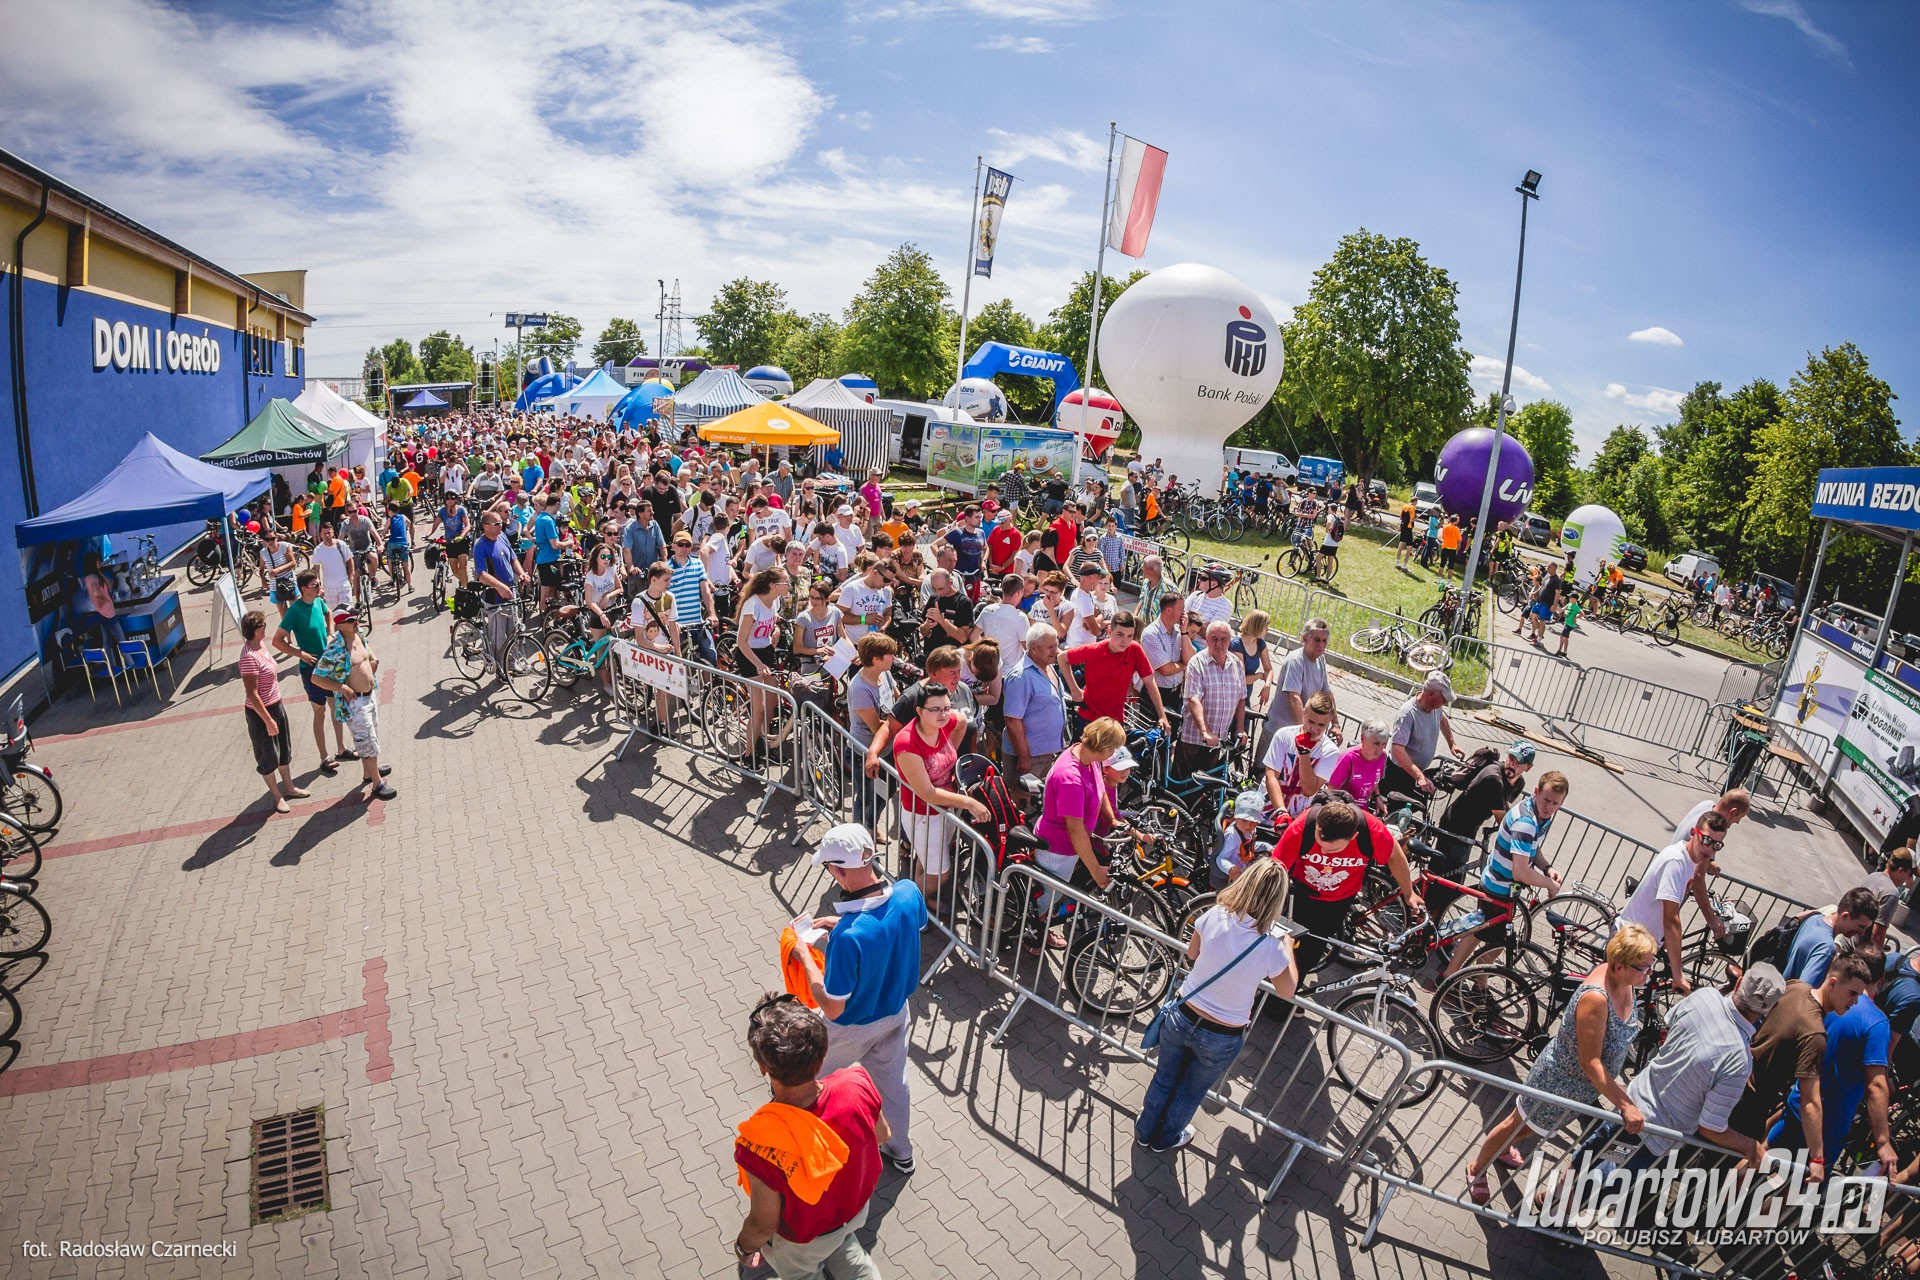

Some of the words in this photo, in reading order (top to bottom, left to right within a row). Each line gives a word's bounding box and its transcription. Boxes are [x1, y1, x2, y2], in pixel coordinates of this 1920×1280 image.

[94, 318, 151, 368] DOM
[154, 328, 162, 370] I
[166, 328, 220, 373] OGRÓD
[661, 359, 686, 369] Liv
[1020, 355, 1066, 373] GIANT
[1197, 384, 1233, 401] Bank
[1233, 390, 1265, 406] Polski
[275, 449, 323, 460] Lubartów
[415, 451, 424, 463] 6
[1434, 458, 1449, 482] iv
[1499, 478, 1534, 504] Liv
[1815, 482, 1866, 507] MYJNIA
[1123, 543, 1158, 555] LEKTRONICZNE
[630, 648, 674, 675] ZAPISY
[1301, 853, 1368, 867] POLSKA
[1315, 975, 1363, 993] DELTA
